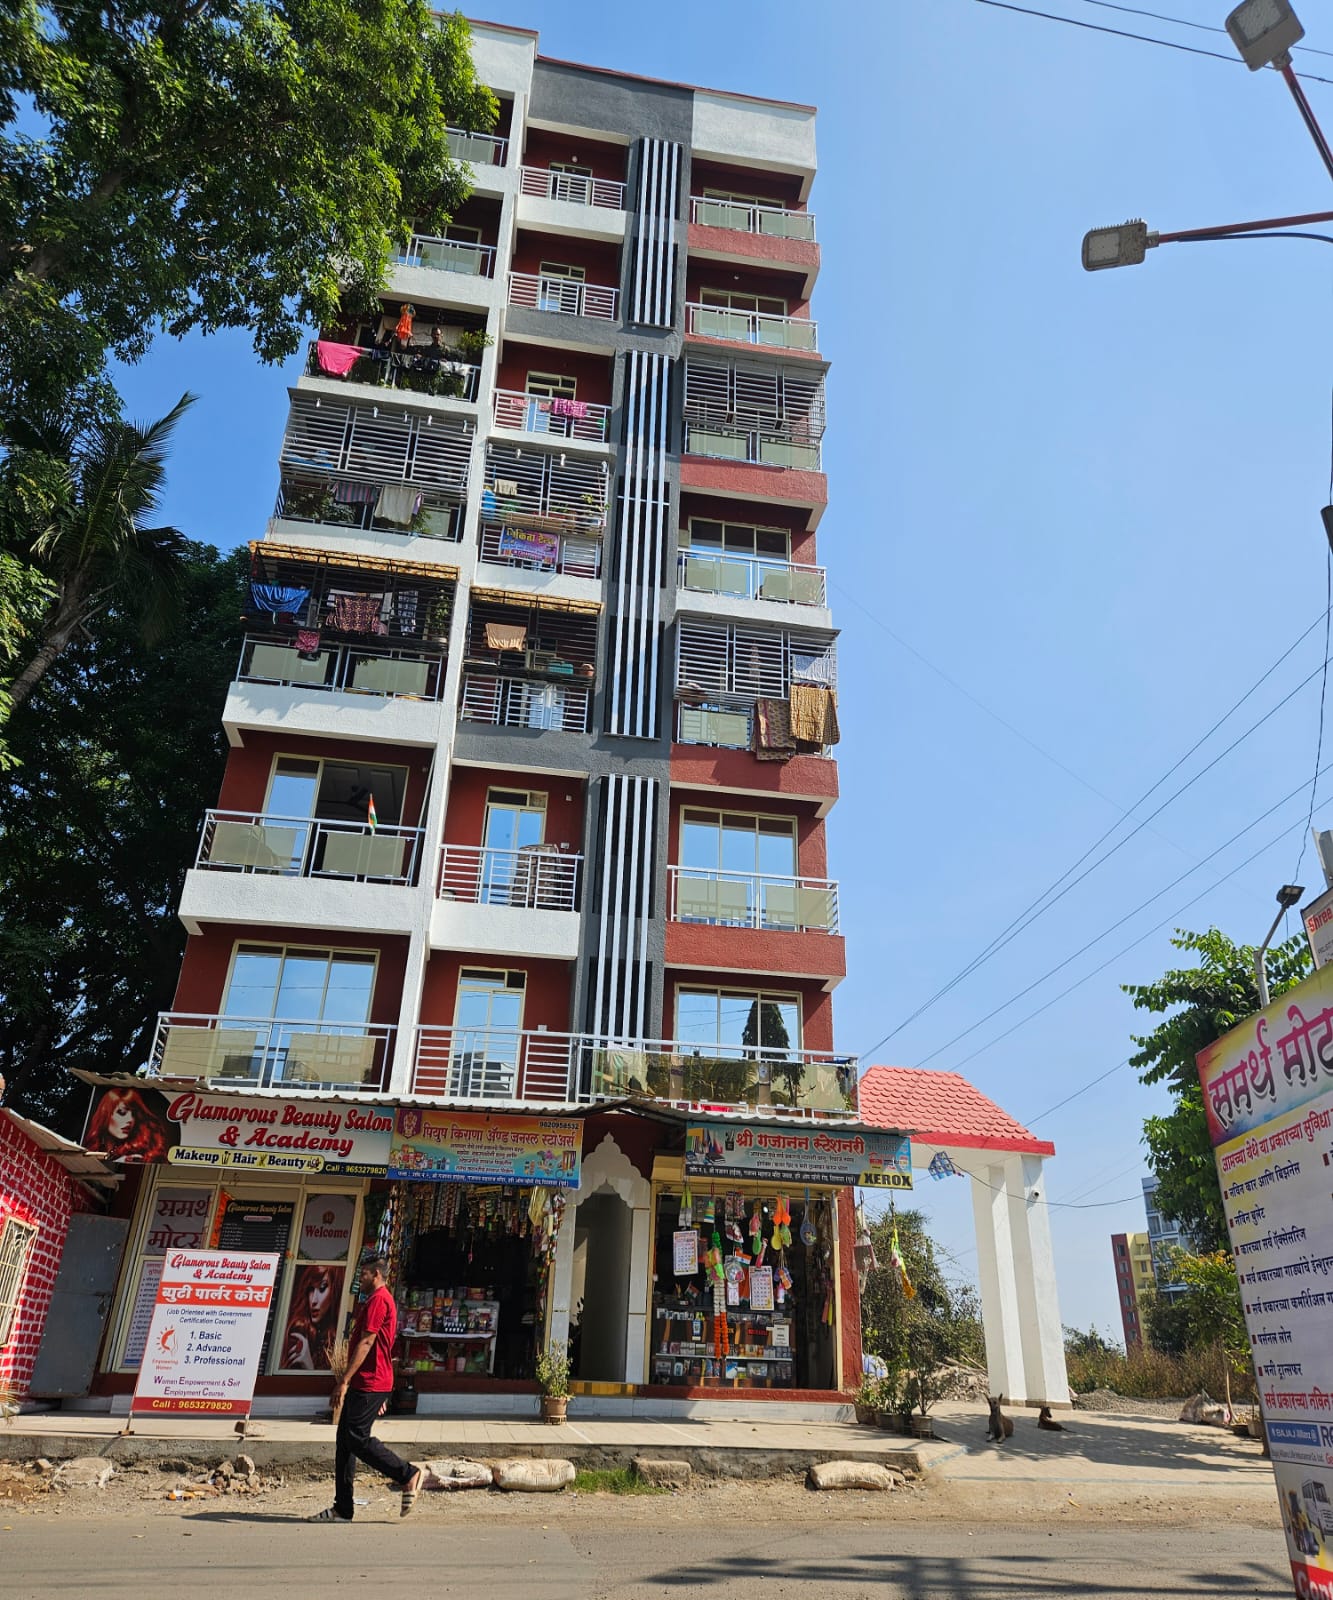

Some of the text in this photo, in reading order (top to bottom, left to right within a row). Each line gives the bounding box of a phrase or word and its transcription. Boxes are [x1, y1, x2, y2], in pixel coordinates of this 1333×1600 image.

[1207, 1018, 1275, 1129] समर्थ
[167, 1092, 393, 1135] Glamorous Beauty Salon
[218, 1125, 354, 1157] & Academy
[736, 1128, 865, 1155] श्री गजानन स्टेशनरी
[174, 1149, 307, 1170] Makeup Hair Beauty
[326, 1164, 338, 1173] Call
[864, 1173, 912, 1187] XEROX
[306, 1225, 348, 1238] Welcome
[171, 1254, 219, 1269] Glamorous
[221, 1258, 248, 1272] Beauty
[249, 1259, 271, 1270] Salon
[193, 1269, 253, 1283] & Academy
[195, 1285, 232, 1300] पार्लर
[235, 1287, 269, 1303] कोर्स
[190, 1331, 222, 1340] 1. Basic
[186, 1343, 232, 1352] 2. Advance
[184, 1356, 245, 1366] 3. Professional
[154, 1376, 178, 1385] Women
[179, 1377, 221, 1386] Empowerment
[227, 1378, 241, 1387] Self
[164, 1386, 201, 1396] Employment
[152, 1400, 171, 1408] Call
[178, 1401, 233, 1410] 9653279820
